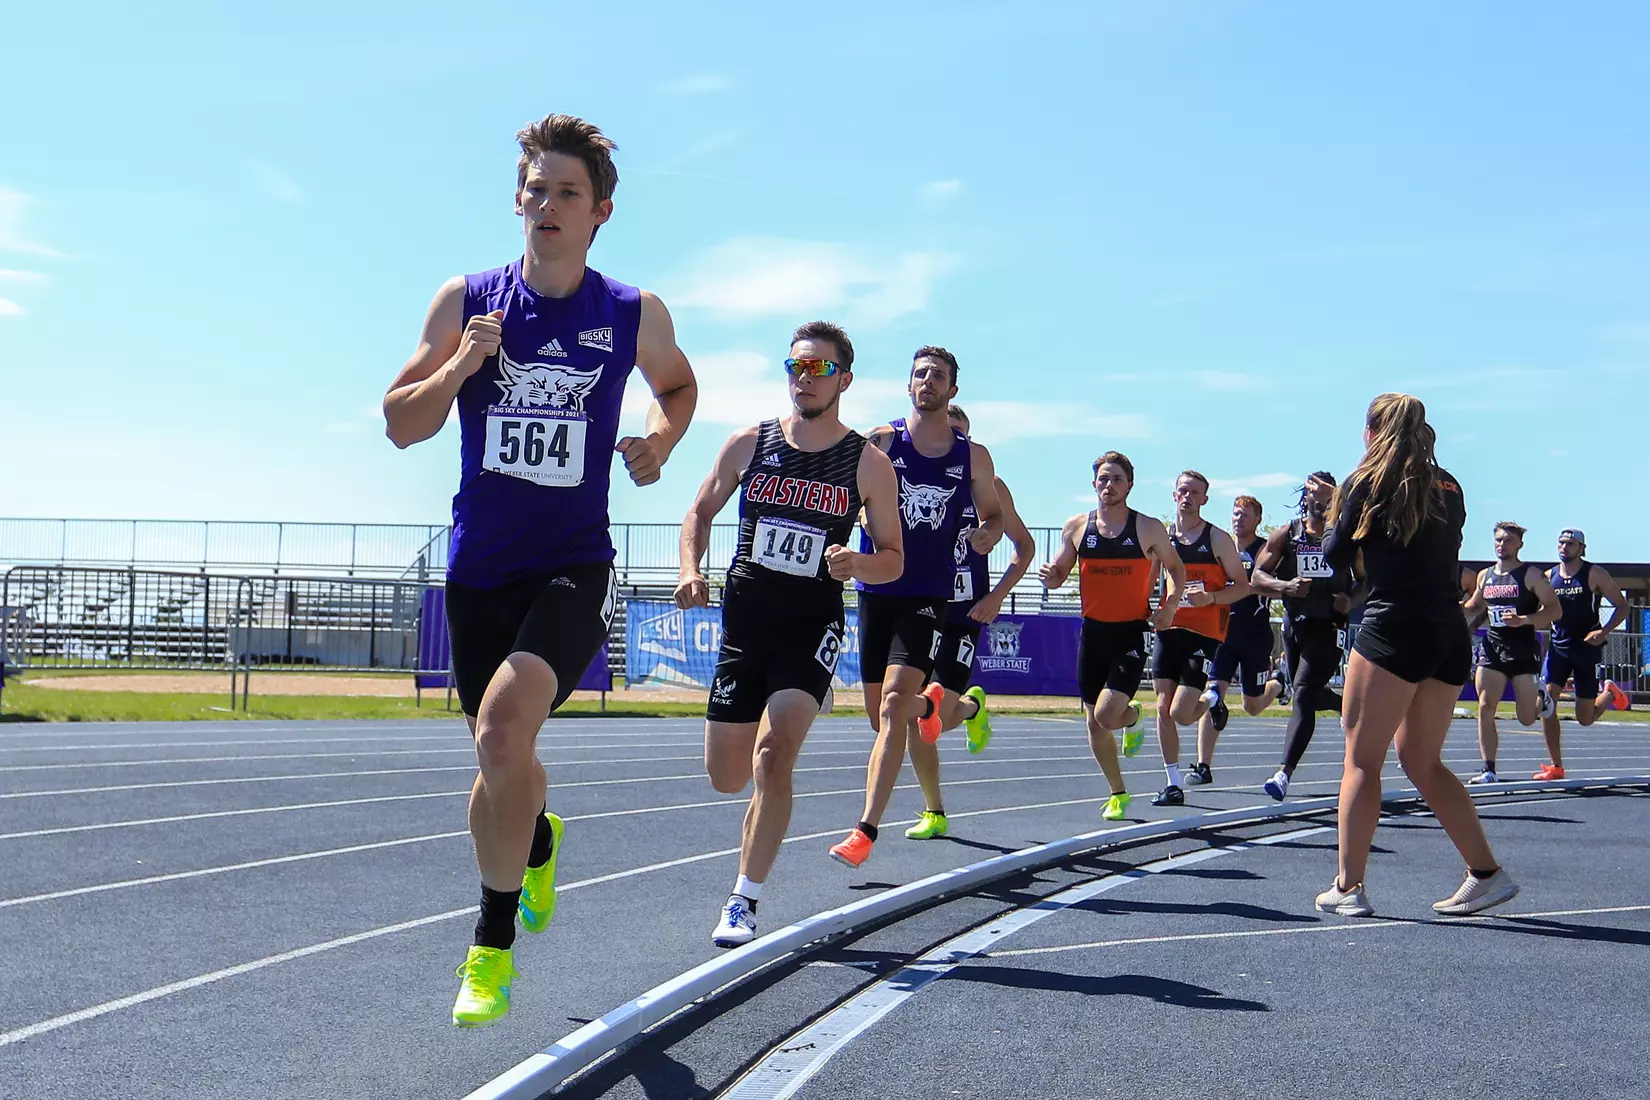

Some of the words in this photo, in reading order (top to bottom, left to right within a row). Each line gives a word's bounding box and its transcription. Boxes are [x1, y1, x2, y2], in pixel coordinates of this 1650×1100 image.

[537, 349, 567, 357] adidas
[499, 421, 570, 468] 564
[541, 472, 573, 480] UNIVERSITY
[747, 473, 849, 516] EASTERN
[763, 528, 814, 565] 149
[1303, 556, 1328, 571] 134
[1555, 587, 1582, 595] OBCATS
[819, 635, 838, 667] 8
[962, 641, 973, 663] 7
[981, 659, 1005, 668] WEBER
[1006, 659, 1027, 670] STATE
